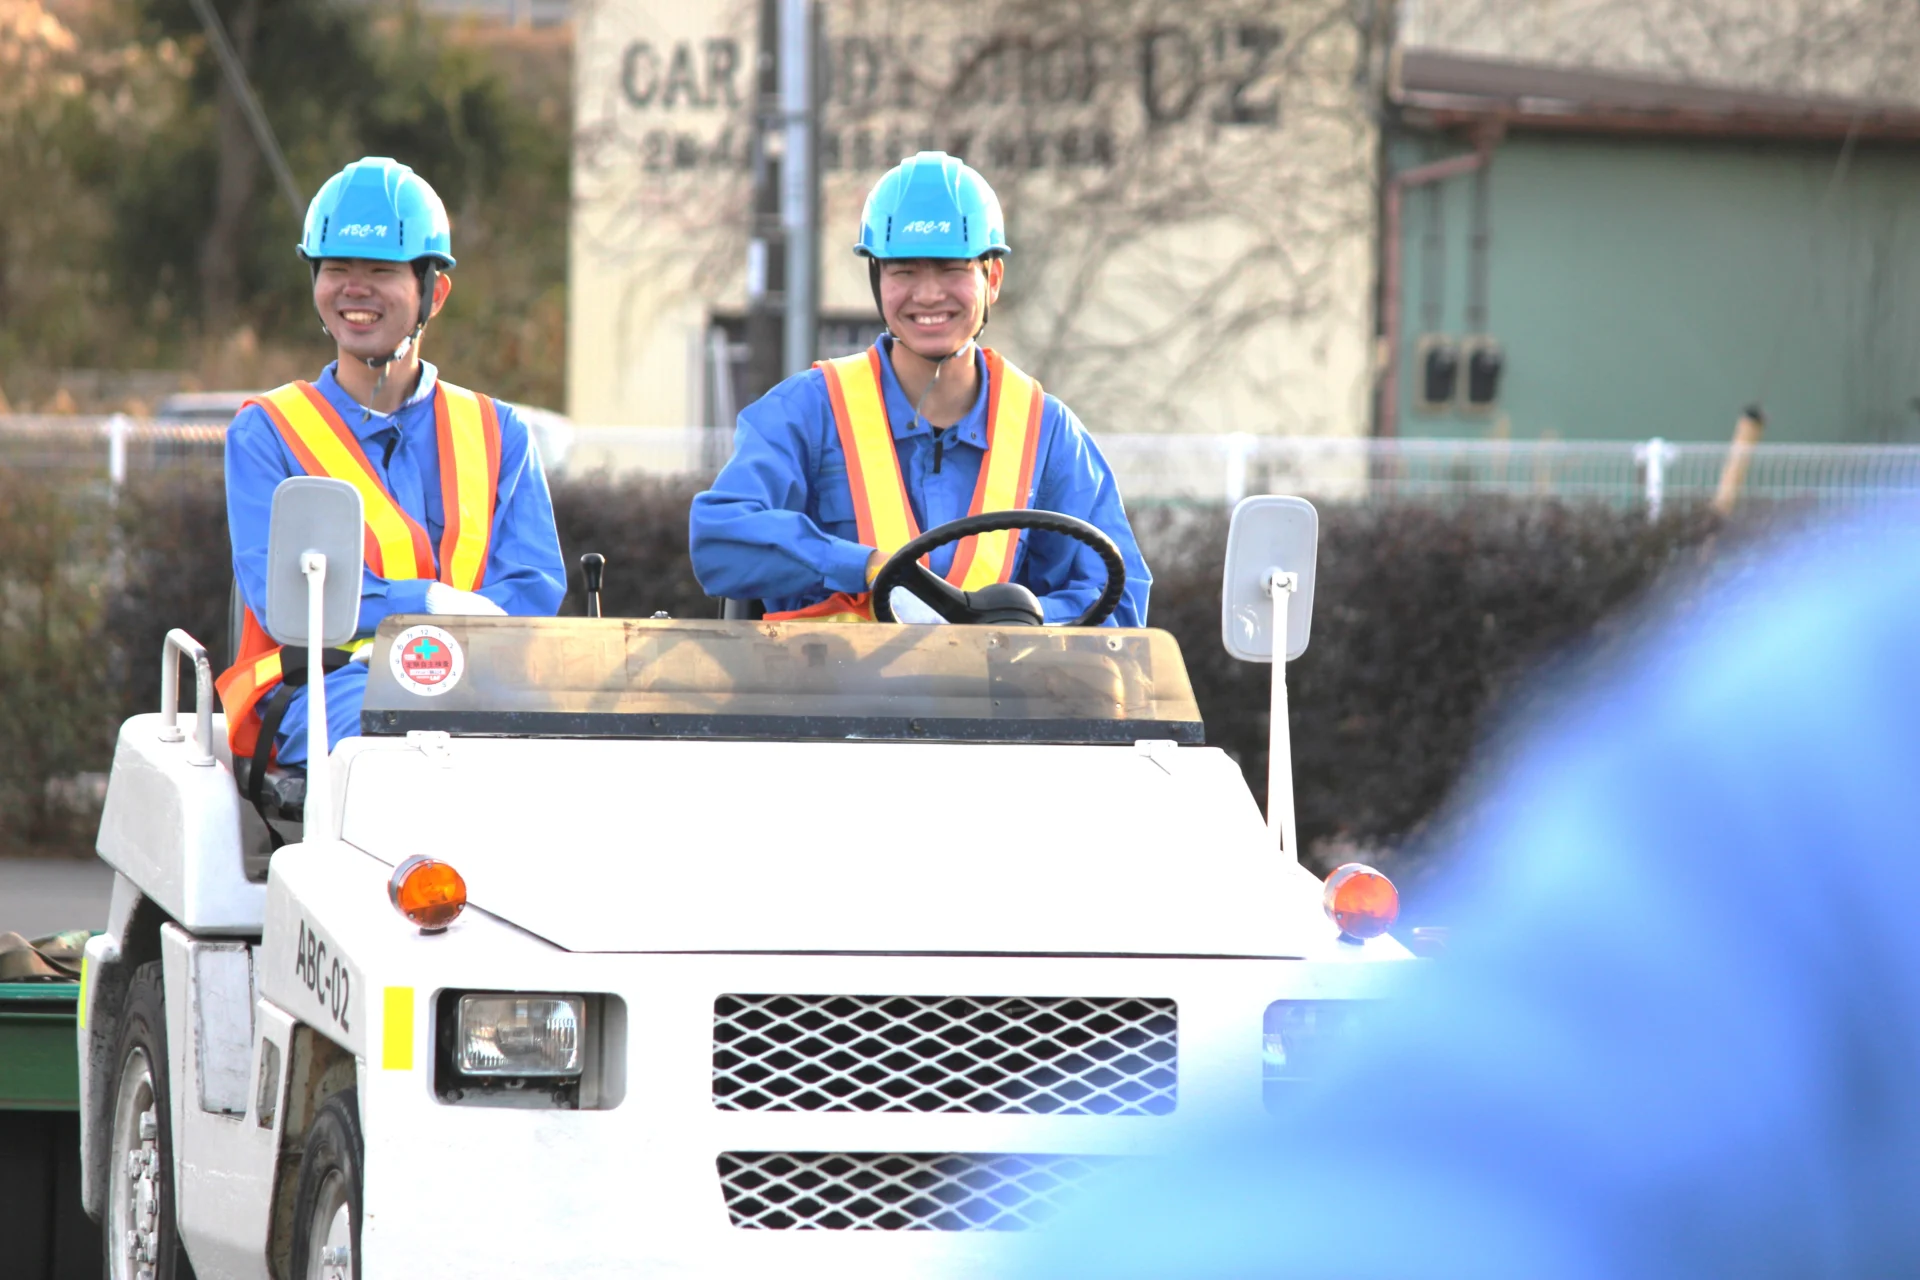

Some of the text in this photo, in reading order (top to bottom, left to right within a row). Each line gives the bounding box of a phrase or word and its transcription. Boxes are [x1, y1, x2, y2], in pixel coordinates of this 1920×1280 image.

[622, 38, 743, 110] CAR
[338, 224, 388, 238] ABC-N
[902, 220, 951, 234] ABC-N
[296, 918, 349, 1034] ABC-02
